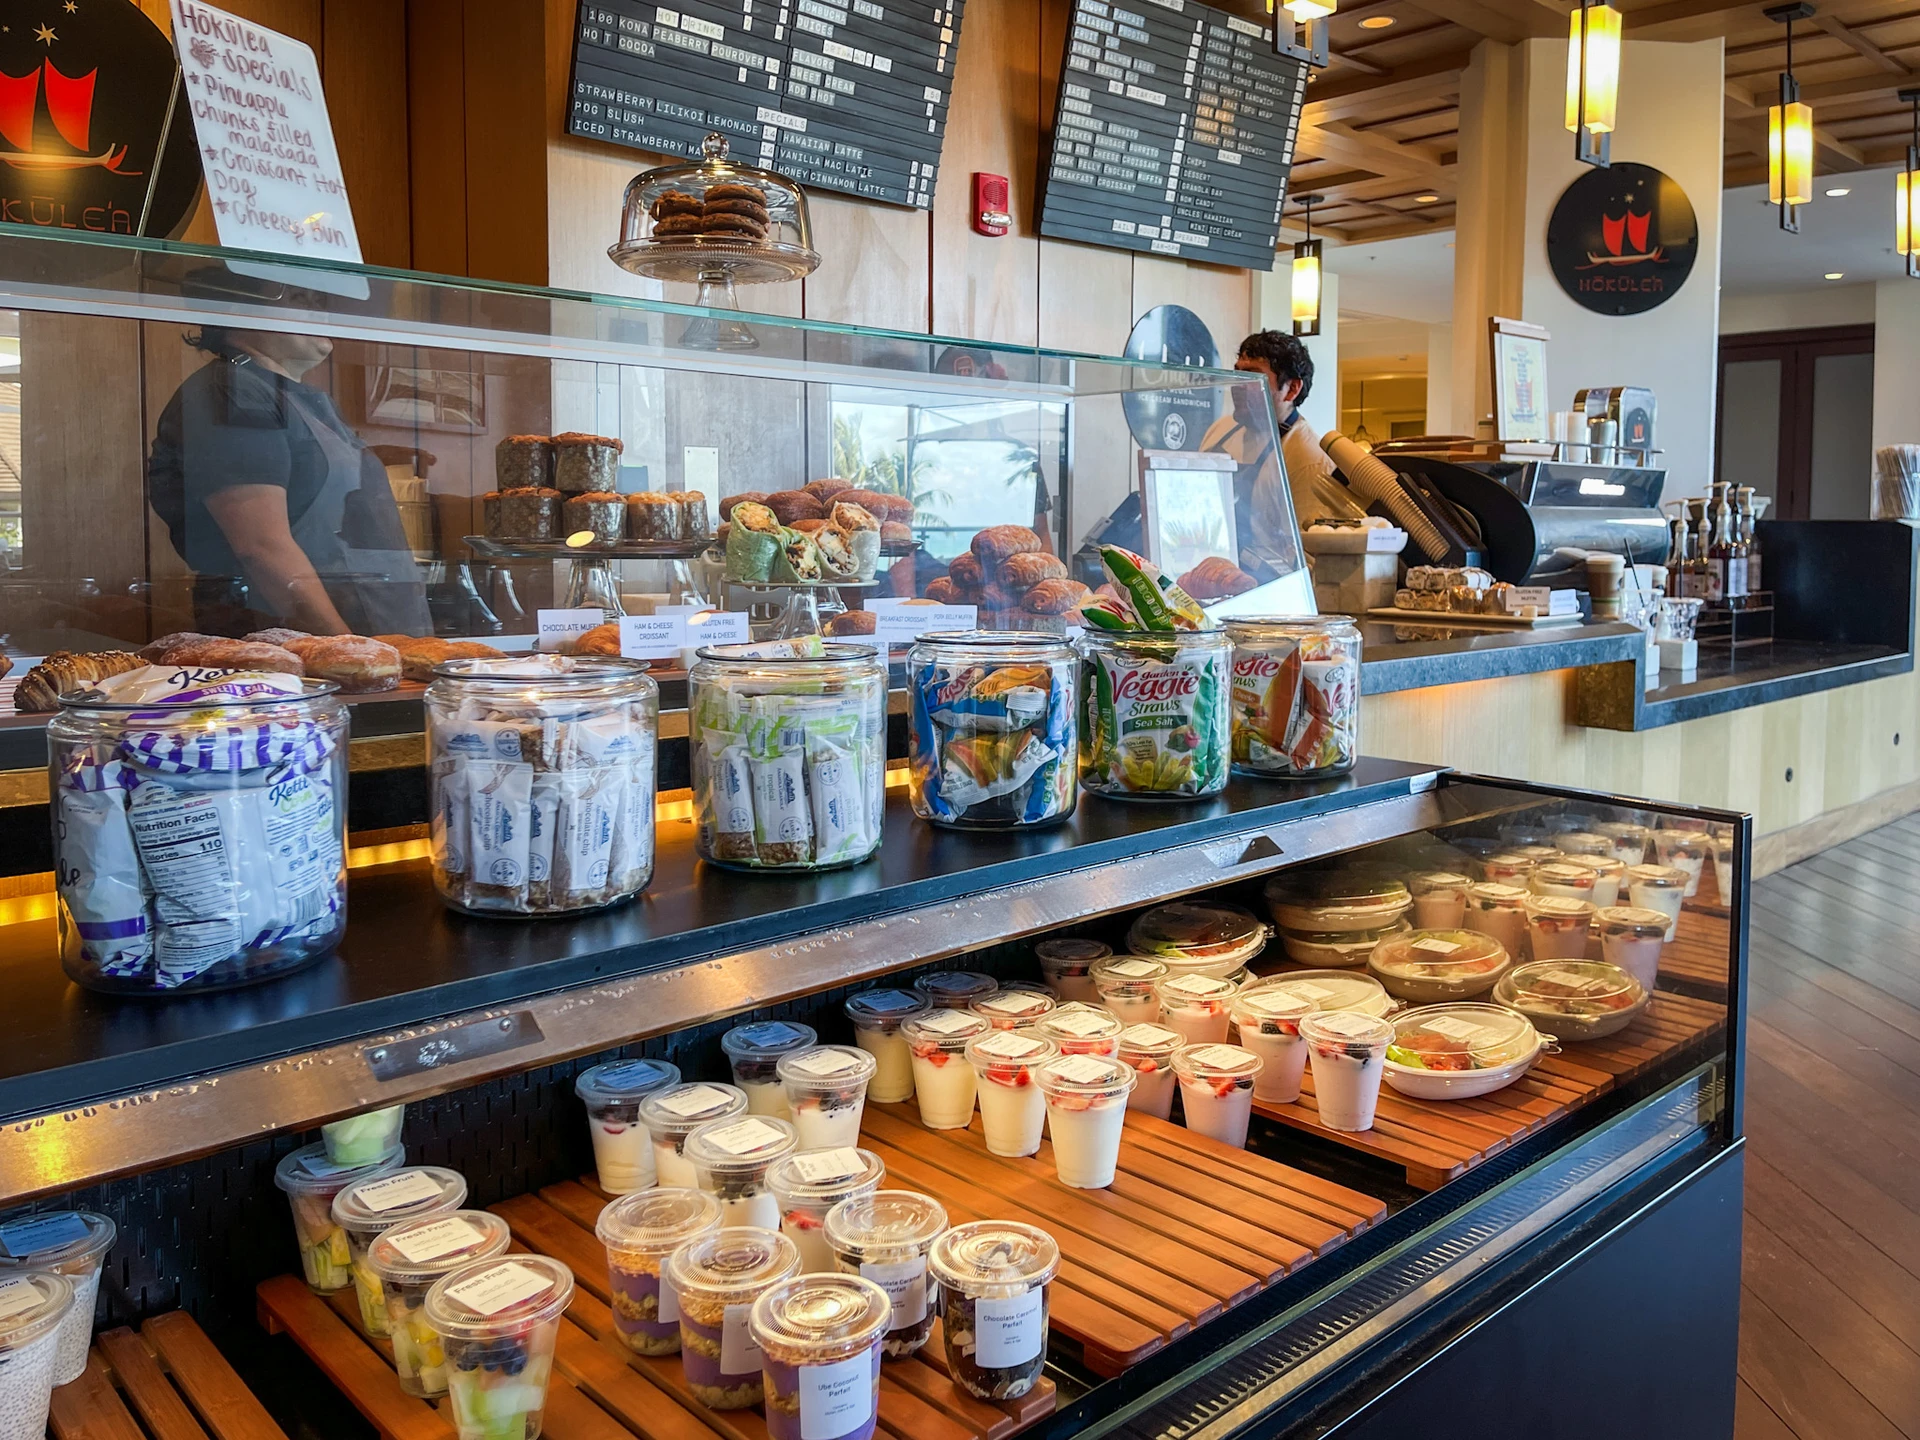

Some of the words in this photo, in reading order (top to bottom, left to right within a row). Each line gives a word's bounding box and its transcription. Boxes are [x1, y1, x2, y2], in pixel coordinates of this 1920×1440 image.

[799, 1, 846, 24] KOMBUCHA
[854, 2, 883, 20] SHOTS
[1114, 9, 1145, 26] PARFAIT
[658, 11, 678, 24] HOT
[682, 16, 723, 38] DRINKS
[798, 16, 834, 37] JUICES
[619, 15, 649, 34] KONA
[653, 28, 709, 50] PEABERRY
[712, 44, 764, 66] POUROVER
[767, 60, 779, 71] 12
[1074, 27, 1098, 43] FRUIT
[619, 36, 655, 56] COCOA
[1207, 39, 1231, 52] CAESAR
[1234, 47, 1253, 60] SALAD
[793, 51, 835, 71] FLAVORS
[1105, 52, 1132, 67] SALMON
[1205, 52, 1229, 66] CHEESE
[1246, 66, 1286, 84] CHARCUTERIE
[790, 67, 821, 85] SWEET
[825, 77, 856, 93] CREAM
[1203, 66, 1230, 81] ITALIAN
[1233, 75, 1252, 88] COMBO
[1255, 82, 1283, 96] SANDWICH
[204, 75, 288, 119] Pineapple
[810, 90, 835, 104] SHOT
[1127, 87, 1165, 104] BREAKFAST
[1201, 79, 1217, 90] TUNA
[1220, 84, 1243, 97] CONFIT
[1245, 92, 1274, 106] SANDWICH
[577, 83, 653, 109] STRAWBERRY
[656, 101, 704, 122] LILIKOI
[707, 115, 758, 135] LEMONADE
[763, 127, 775, 138] 14
[1241, 104, 1255, 114] TOFU
[574, 101, 599, 115] POG
[607, 108, 645, 126] SLUSH
[761, 144, 774, 154] 14
[758, 110, 806, 130] SPECIALS
[1062, 113, 1104, 131] VEGETABLE
[1108, 124, 1139, 139] BURRITO
[267, 121, 316, 150] filled
[575, 120, 605, 135] ICED
[613, 128, 683, 151] STRAWBERRY
[1060, 127, 1093, 142] CHICKEN
[1095, 134, 1126, 150] SAUSAGE
[1130, 143, 1160, 158] BURRITO
[1193, 131, 1219, 145] TRUFFLE
[1223, 139, 1234, 149] EGG
[1238, 143, 1266, 156] SANDWICH
[1239, 130, 1254, 140] WRAP
[229, 130, 319, 168] malasada
[783, 132, 830, 152] HAWAIIAN
[834, 144, 863, 160] LATTE
[1058, 140, 1072, 152] HAM
[1075, 144, 1090, 155] AND
[1093, 149, 1120, 162] CHEESE
[1122, 155, 1160, 170] CROISSANT
[780, 148, 821, 165] VANILLA
[824, 159, 842, 170] MAC
[845, 163, 873, 179] LATTE
[1055, 155, 1074, 166] PORK
[1078, 159, 1101, 172] BELLY
[1104, 165, 1134, 178] ENGLISH
[1137, 172, 1163, 185] MUFFIN
[1186, 157, 1206, 168] CHIPS
[778, 165, 808, 178] HONEY
[810, 172, 855, 189] CINNAMON
[858, 182, 886, 196] LATTE
[1052, 168, 1094, 184] BREAKFAST
[1098, 177, 1136, 193] CROISSANT
[1184, 169, 1211, 181] DESSERT
[213, 169, 257, 206] Dog
[313, 173, 347, 200] Hot
[1182, 182, 1209, 194] GRANOLA
[1211, 188, 1223, 197] BAR
[1195, 198, 1215, 208] CANDY
[233, 201, 305, 244] Cheesy
[1177, 207, 1200, 218] UNCLES
[1203, 212, 1234, 224] HAWAIIAN
[987, 226, 1002, 234] FIRE
[1190, 223, 1206, 232] MINI
[1209, 227, 1220, 235] ICE
[1223, 229, 1242, 238] CREAM
[1173, 396, 1211, 408] SANDWICHES
[542, 623, 579, 632] CHOCOLATE
[634, 622, 647, 630] HAM
[654, 621, 673, 630] CHEESE
[721, 618, 735, 626] FREE
[639, 632, 669, 640] CROISSANT
[718, 631, 737, 639] CHEESE
[1141, 669, 1179, 680] garden
[202, 684, 233, 696] SWEET
[1110, 670, 1199, 705] Veggie
[1129, 699, 1180, 717] Straws
[1135, 719, 1153, 728] Sea
[1155, 717, 1174, 726] Salt
[766, 774, 776, 802] tropical
[135, 819, 181, 832] Nutrition
[185, 811, 216, 824] Facts
[583, 798, 593, 837] chocolate
[199, 839, 222, 851] 110
[483, 834, 491, 850] chip
[580, 838, 590, 856] chip
[361, 1182, 390, 1194] Fresh
[391, 1174, 416, 1186] Fruit
[395, 1229, 426, 1243] Fresh
[427, 1221, 453, 1233] Fruit
[454, 1278, 485, 1294] Fresh
[485, 1266, 510, 1281] Fruit
[1016, 1305, 1038, 1318] Caramel
[1002, 1320, 1022, 1329] Parfait
[833, 1374, 859, 1388] Coconut
[829, 1386, 851, 1397] Parfait
